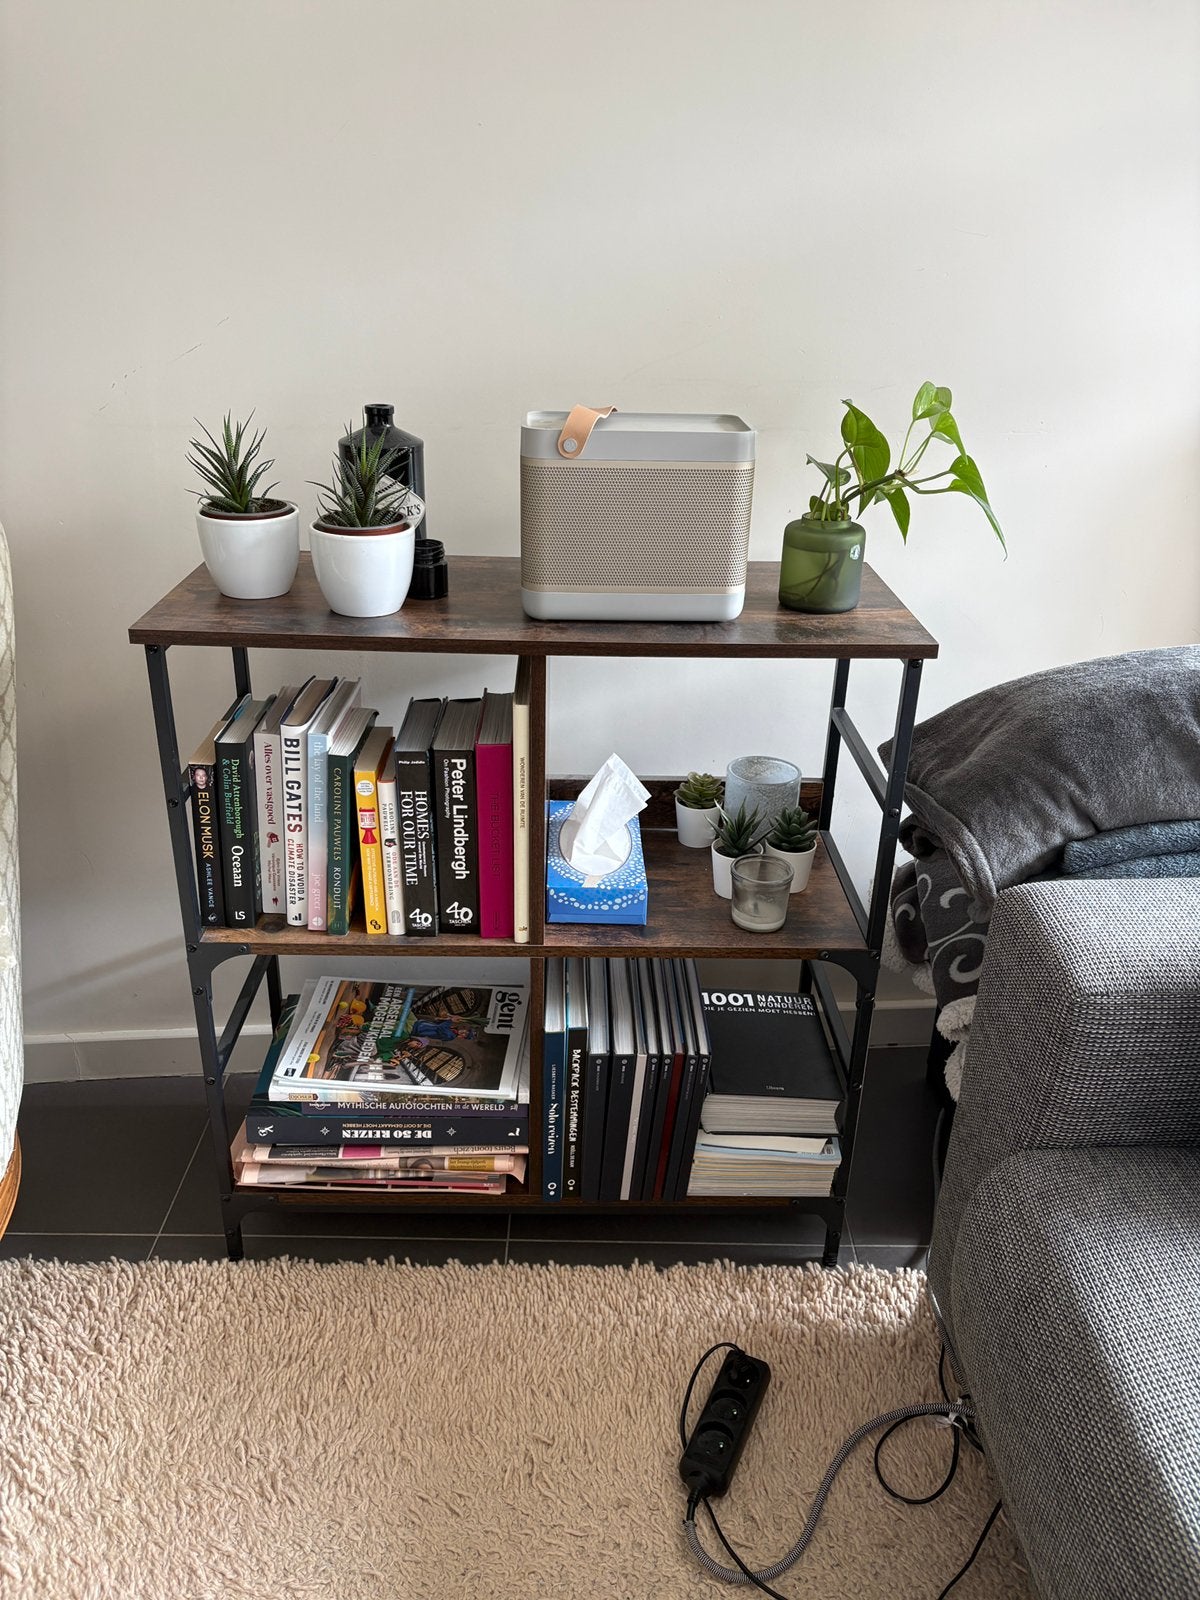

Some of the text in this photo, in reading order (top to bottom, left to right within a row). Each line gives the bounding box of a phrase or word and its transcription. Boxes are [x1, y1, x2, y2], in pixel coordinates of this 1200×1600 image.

[263, 741, 273, 764] Alles
[443, 759, 449, 767] On
[222, 758, 234, 825] & Colin Butfield
[231, 759, 244, 839] David Attenborough
[284, 738, 303, 833] BILL GATES
[312, 741, 324, 823] the lay of the land
[265, 787, 276, 825] vastgoed
[333, 767, 342, 861] CAROLINE PAUWELS
[387, 802, 395, 835] CAROLINE
[414, 790, 430, 839] HOMES
[451, 759, 470, 879] Peter Lindbergh
[519, 800, 526, 808] DE
[198, 792, 214, 858] ELON MUSK
[400, 791, 418, 886] FOR OUR TIME
[231, 845, 244, 887] Oceaan
[296, 843, 304, 860] HOW
[297, 861, 304, 871] TO
[205, 863, 215, 908] ASHLEE VANCE
[287, 838, 297, 905] CLIMATE DISASTER
[297, 873, 305, 895] AVOID
[333, 867, 342, 909] RONDUIT
[386, 852, 395, 901] VERWONDERING
[393, 881, 399, 889] DE
[311, 873, 324, 910] joe greer
[409, 908, 432, 925] 40
[446, 902, 473, 922] 40
[379, 987, 403, 1039] EEN ARSENAAL
[495, 990, 522, 1030] gent
[701, 992, 812, 1007] 1001 NATUUR
[757, 1001, 814, 1011] WONDEREN
[357, 985, 394, 1062] AAN MOGELIJKHEDEN
[337, 1101, 387, 1109] MYTHISCHE
[471, 1103, 505, 1111] WERELD
[548, 1103, 559, 1124] Solo
[568, 1049, 581, 1142] BACKPACK BESTEMMINGEN
[342, 1129, 432, 1139] DE 50 REIZEN
[453, 1145, 470, 1154] zich
